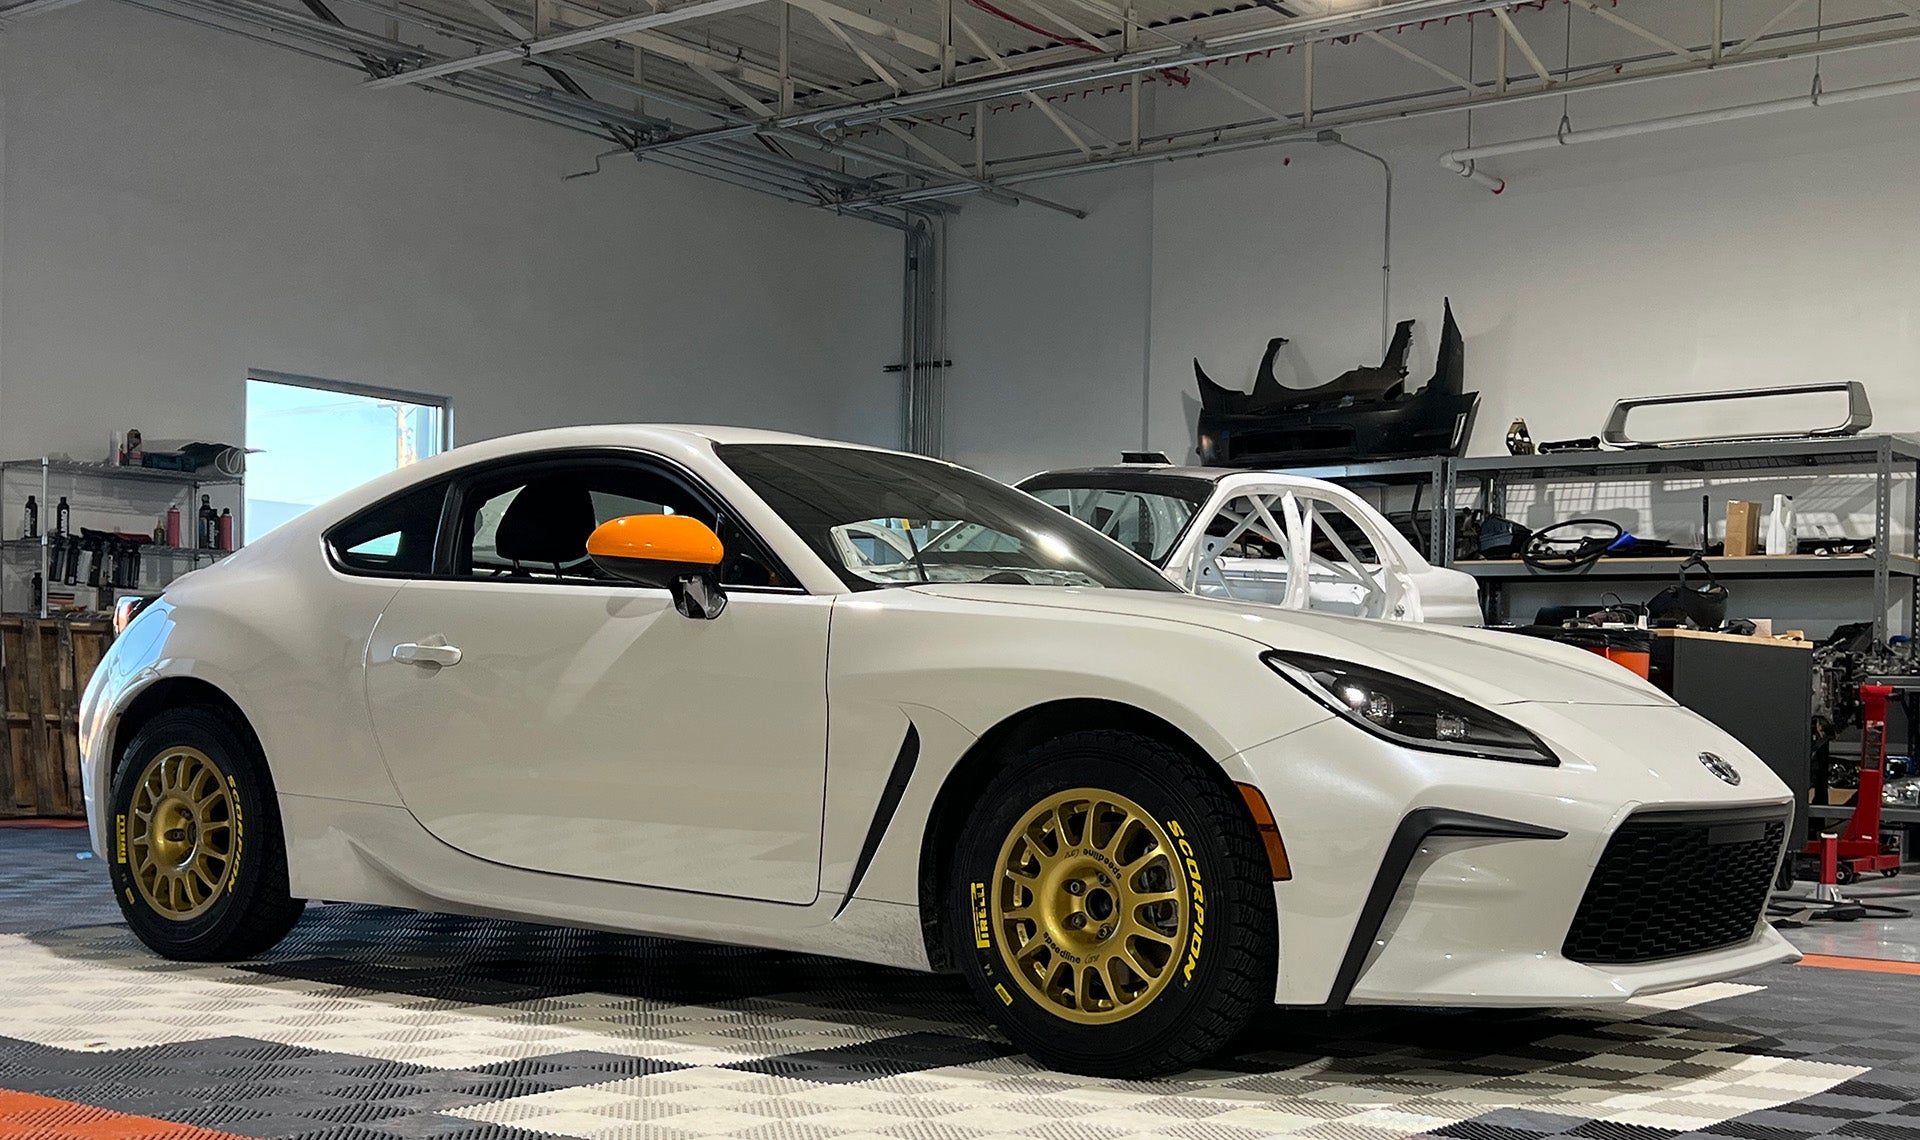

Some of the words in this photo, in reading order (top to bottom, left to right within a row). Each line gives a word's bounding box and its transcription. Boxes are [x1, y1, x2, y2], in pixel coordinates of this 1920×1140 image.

[227, 775, 243, 893] SCORPION
[1083, 848, 1122, 880] speedline
[971, 882, 991, 948] PIRELLI
[1167, 820, 1205, 981] SCORPION
[1043, 931, 1081, 964] speedline
